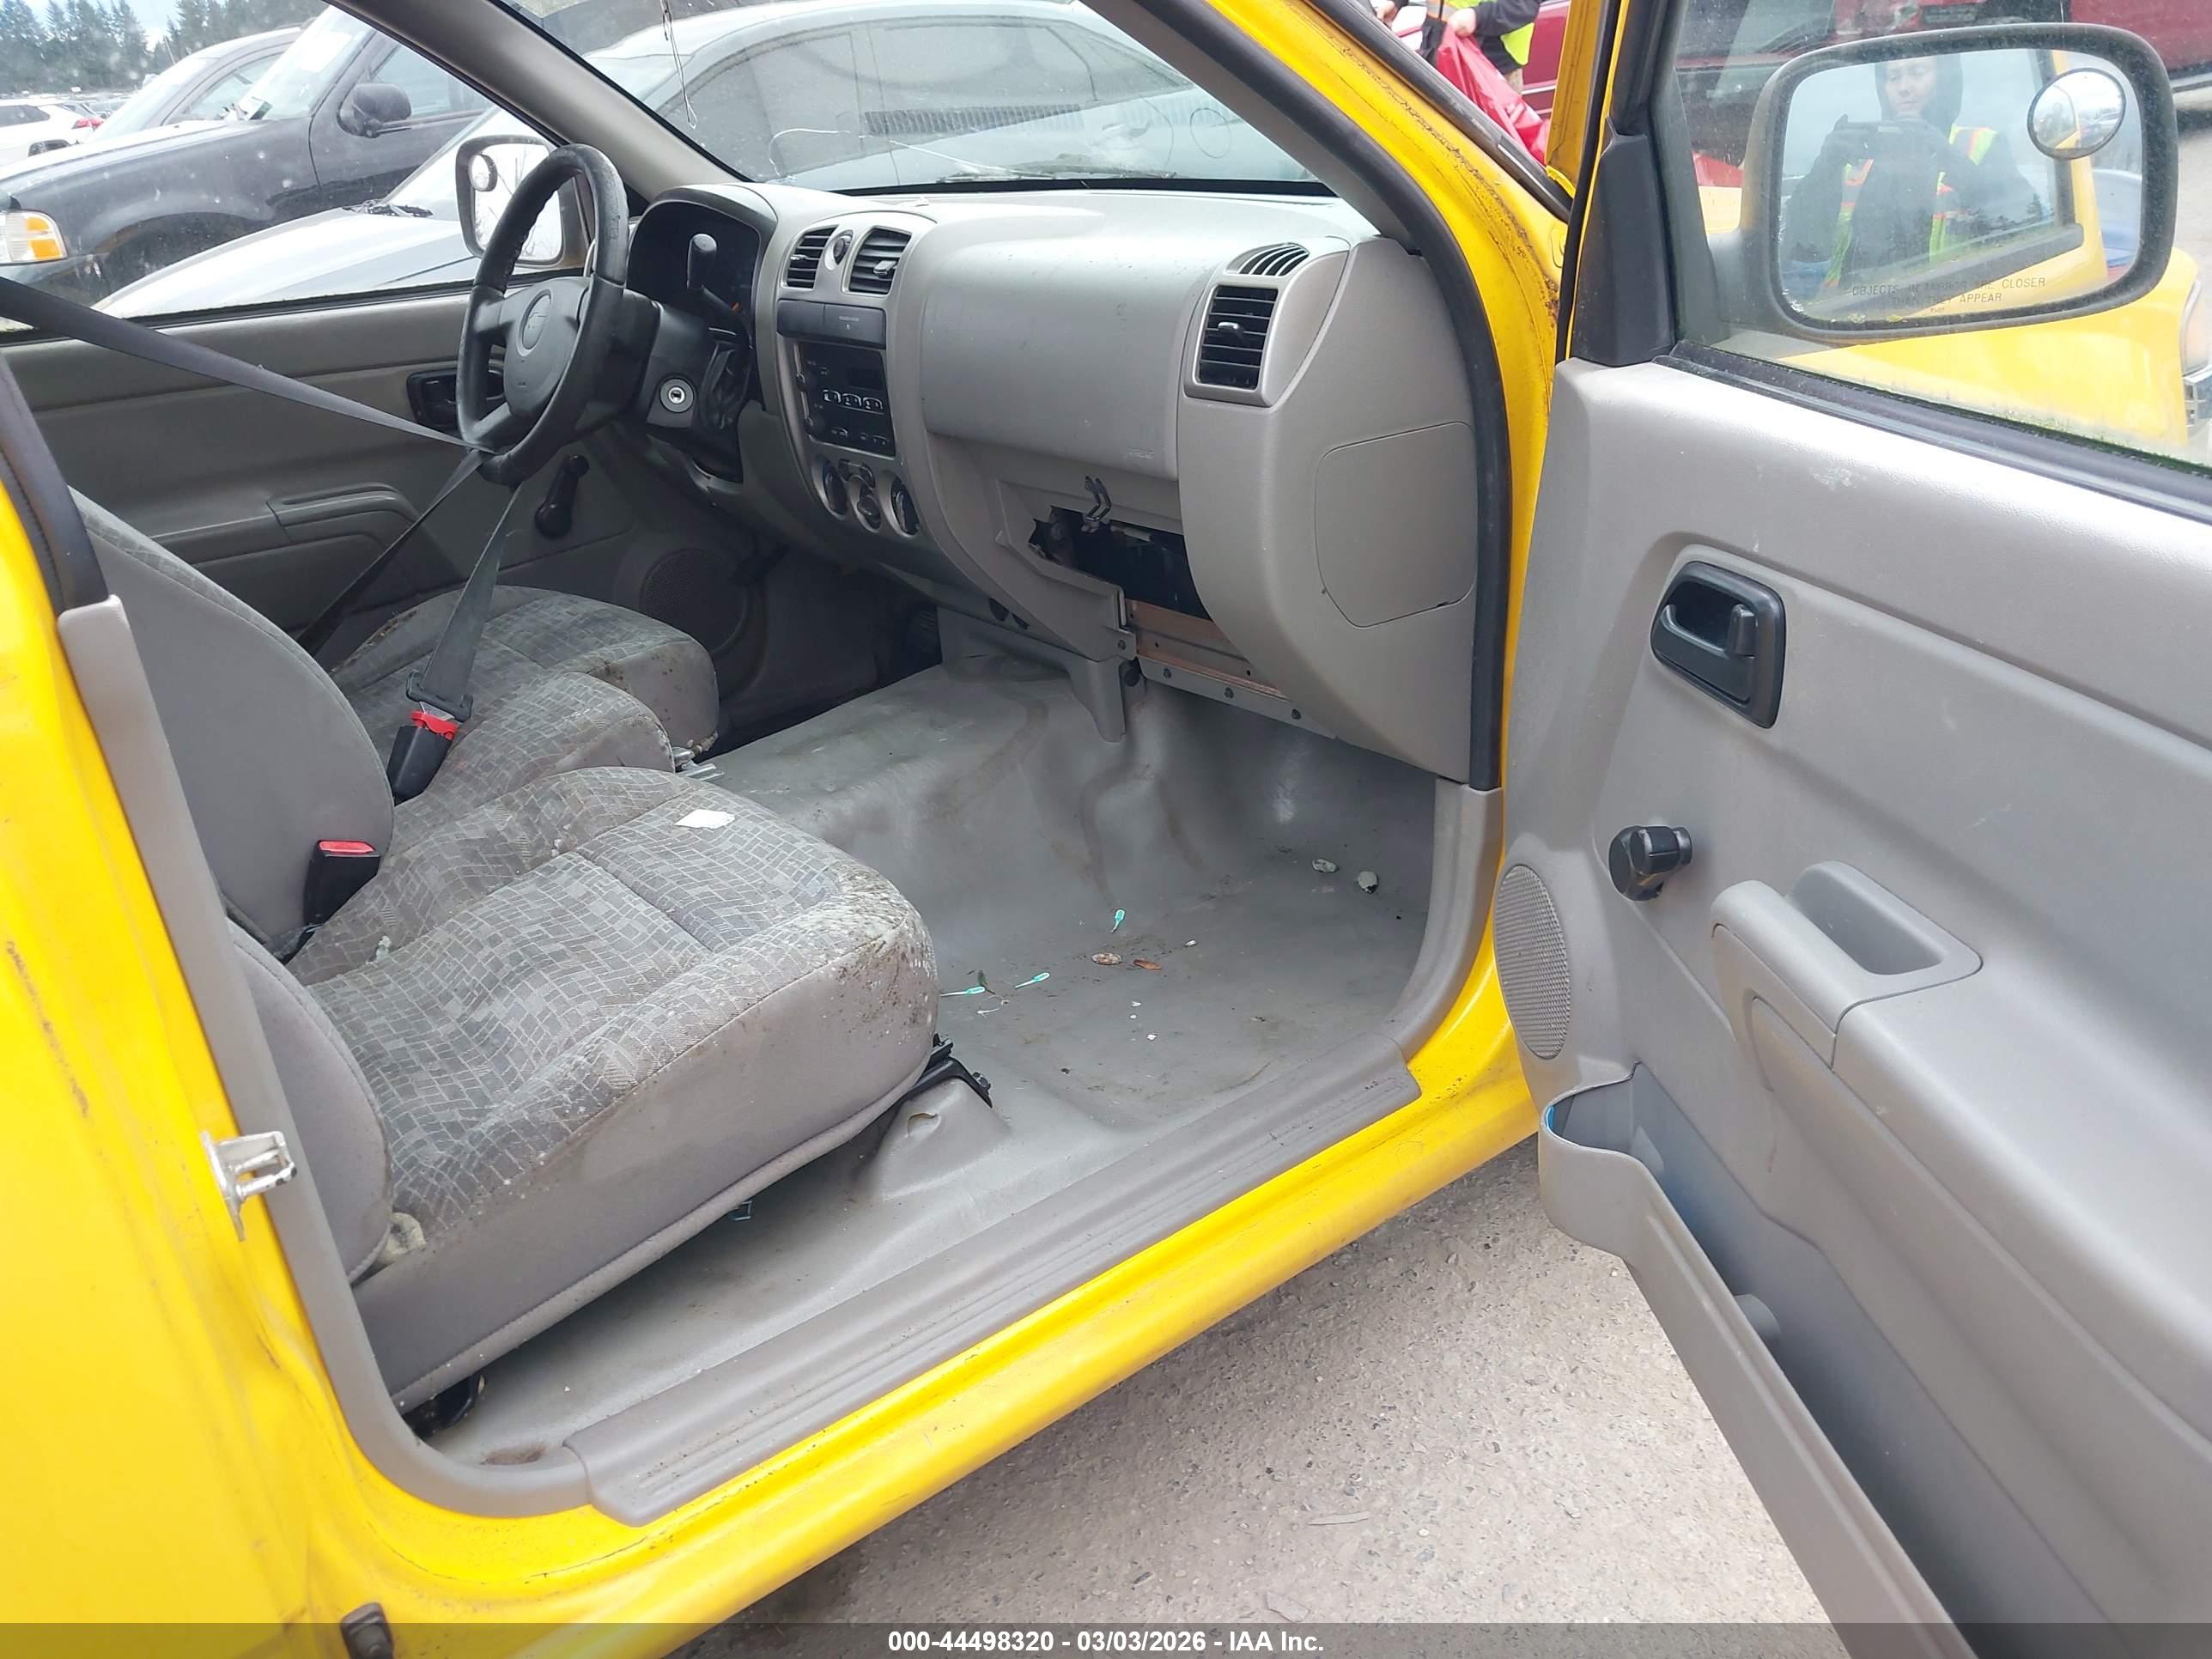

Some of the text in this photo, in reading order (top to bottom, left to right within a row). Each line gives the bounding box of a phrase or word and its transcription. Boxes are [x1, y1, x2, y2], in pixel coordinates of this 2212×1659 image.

[1852, 284, 1898, 296] OBJECTS
[1907, 283, 1918, 294] IN
[2002, 277, 2046, 289] CLOSER
[1960, 292, 2002, 303] APPEAR
